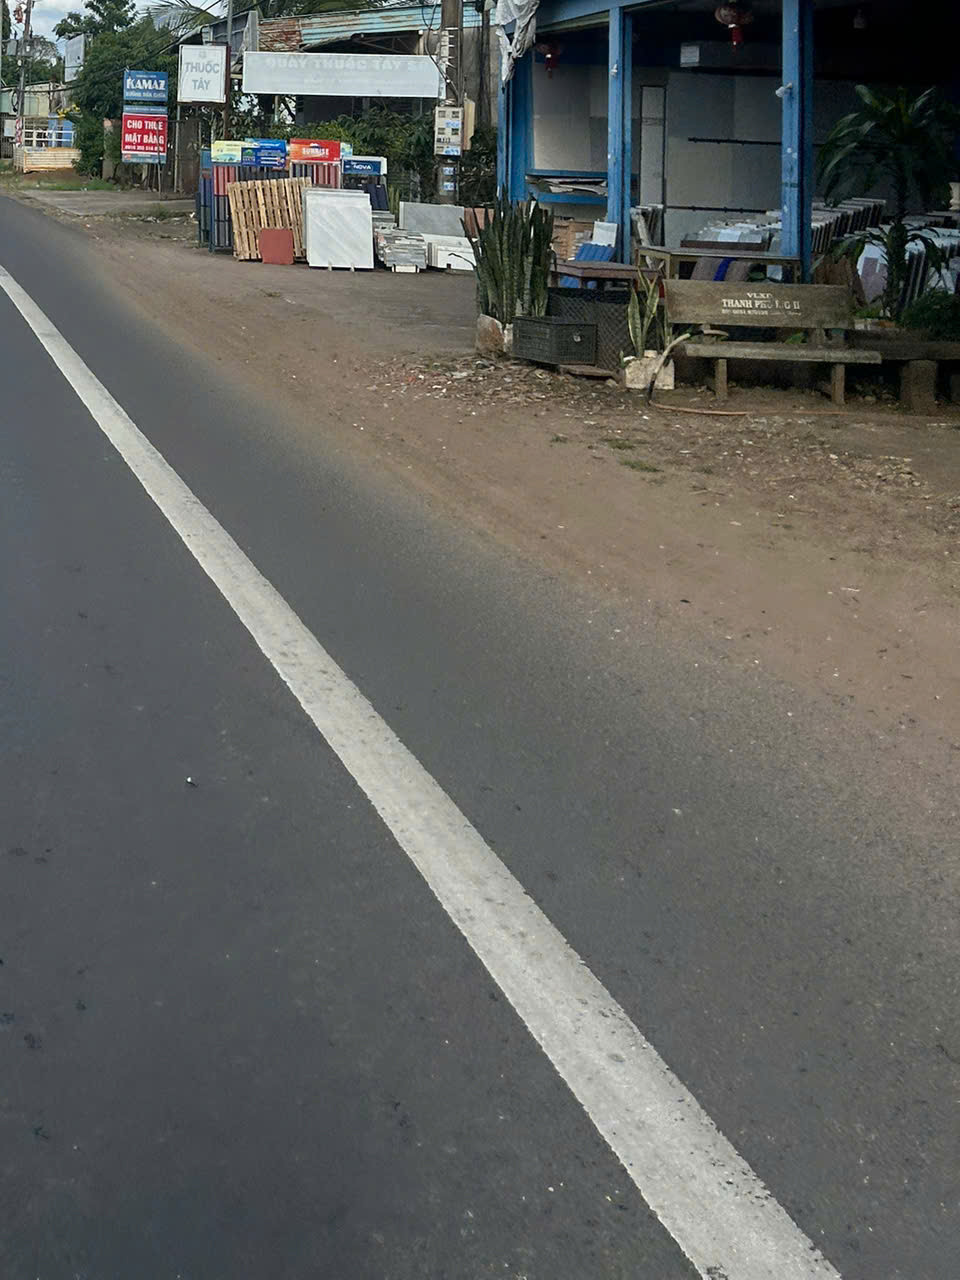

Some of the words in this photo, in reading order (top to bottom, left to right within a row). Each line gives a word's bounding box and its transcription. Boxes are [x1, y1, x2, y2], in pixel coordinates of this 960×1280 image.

[126, 76, 166, 90] KAMAZ
[191, 77, 210, 90] TÂY
[127, 120, 143, 129] CHO
[722, 299, 753, 308] THANH
